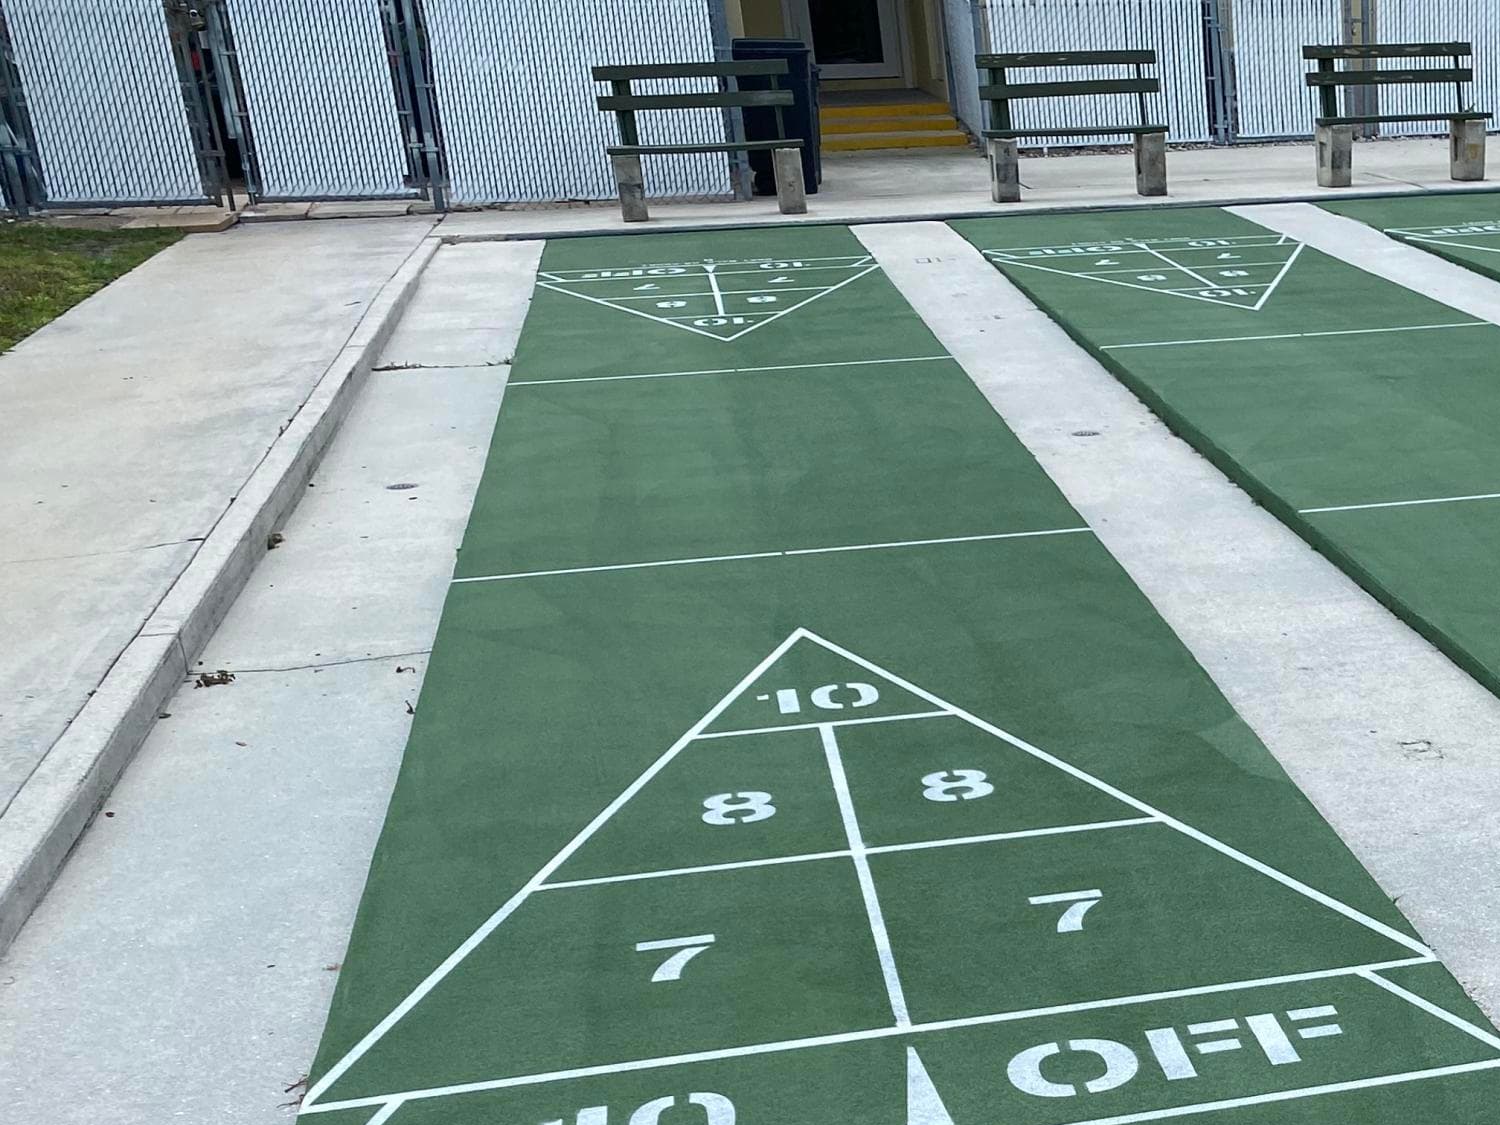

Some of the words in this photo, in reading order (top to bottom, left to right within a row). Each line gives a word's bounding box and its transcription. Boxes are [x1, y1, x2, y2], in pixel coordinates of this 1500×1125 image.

[757, 683, 878, 713] 10
[921, 770, 994, 801] 8
[702, 792, 776, 825] 8
[1028, 889, 1102, 932] 7
[636, 934, 715, 982] 7
[1007, 1005, 1342, 1097] OFF
